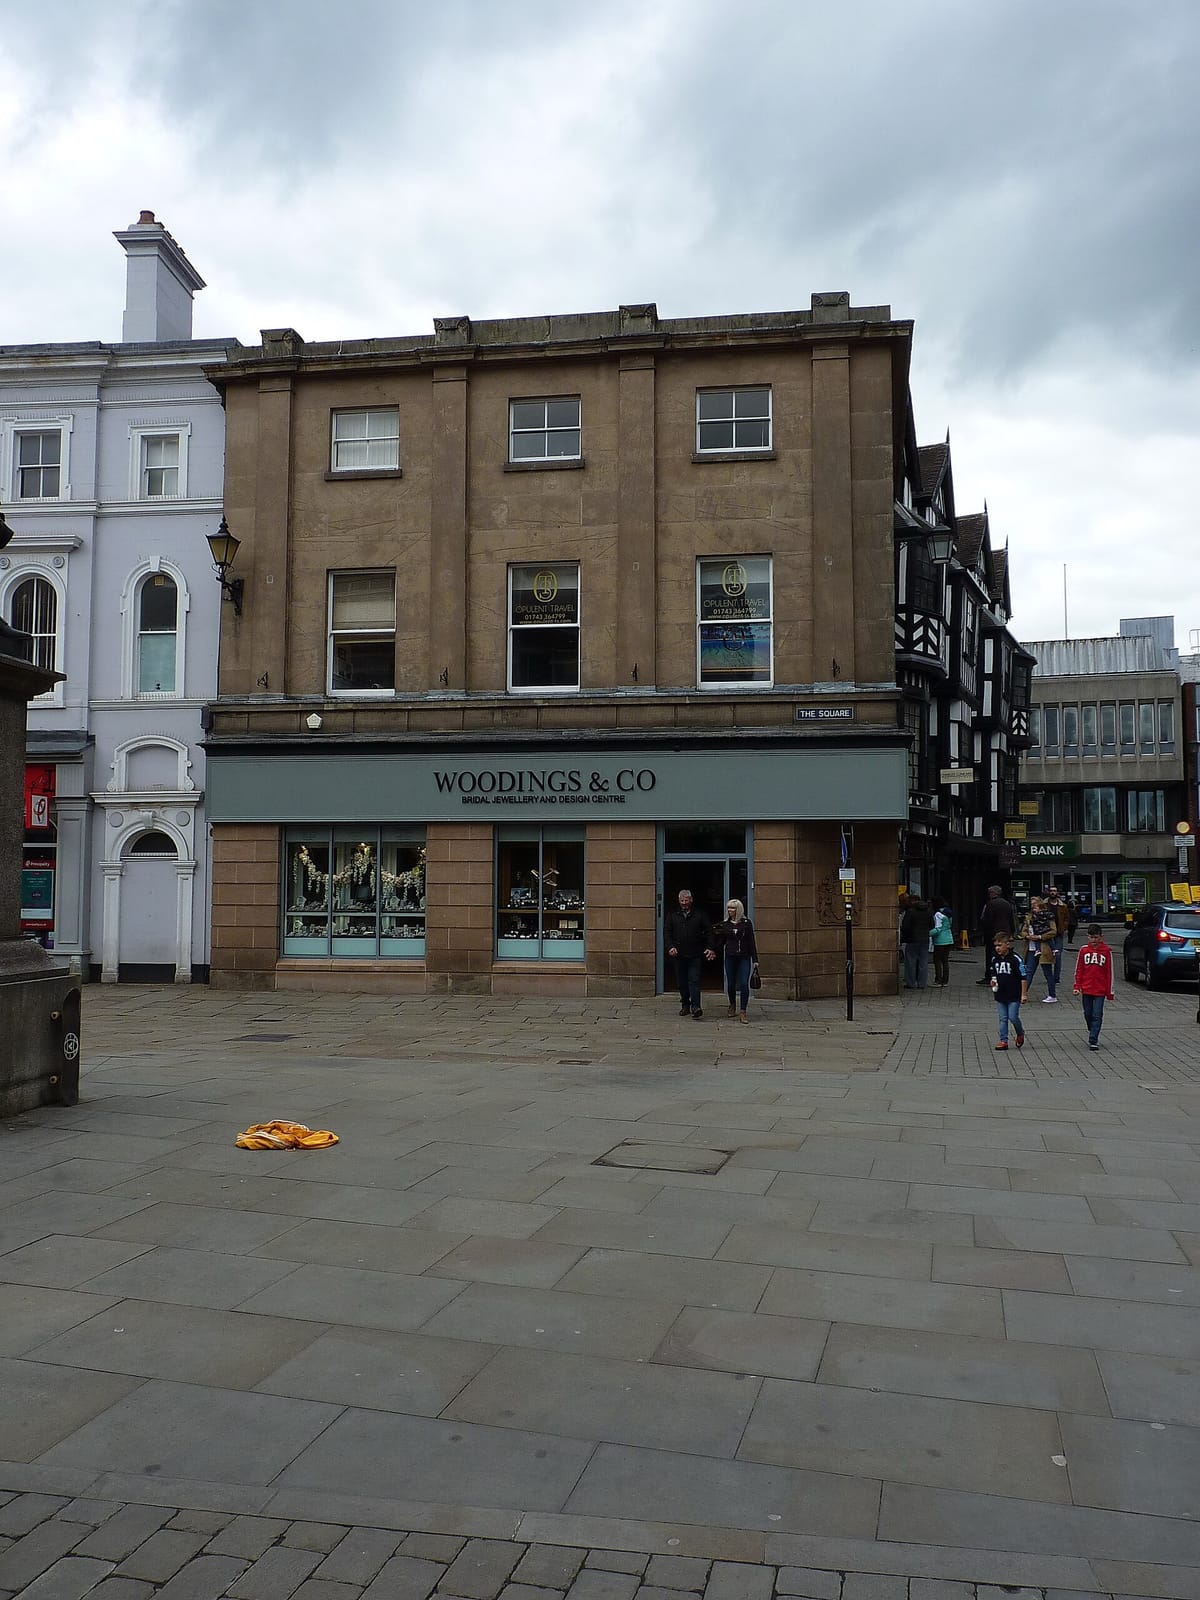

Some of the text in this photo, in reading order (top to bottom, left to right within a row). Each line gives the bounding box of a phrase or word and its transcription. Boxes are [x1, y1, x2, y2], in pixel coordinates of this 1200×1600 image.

[703, 598, 766, 608] OPULENT TRAVEL
[515, 604, 576, 613] OPULENT TRAVEL
[800, 709, 850, 718] THE SQUARE
[433, 769, 656, 793] WOODINGS & CO
[462, 795, 625, 804] BRIDAL JEWELLERY AND DESIGN CENTRE
[1030, 845, 1065, 856] BANK
[1083, 952, 1107, 967] GAP
